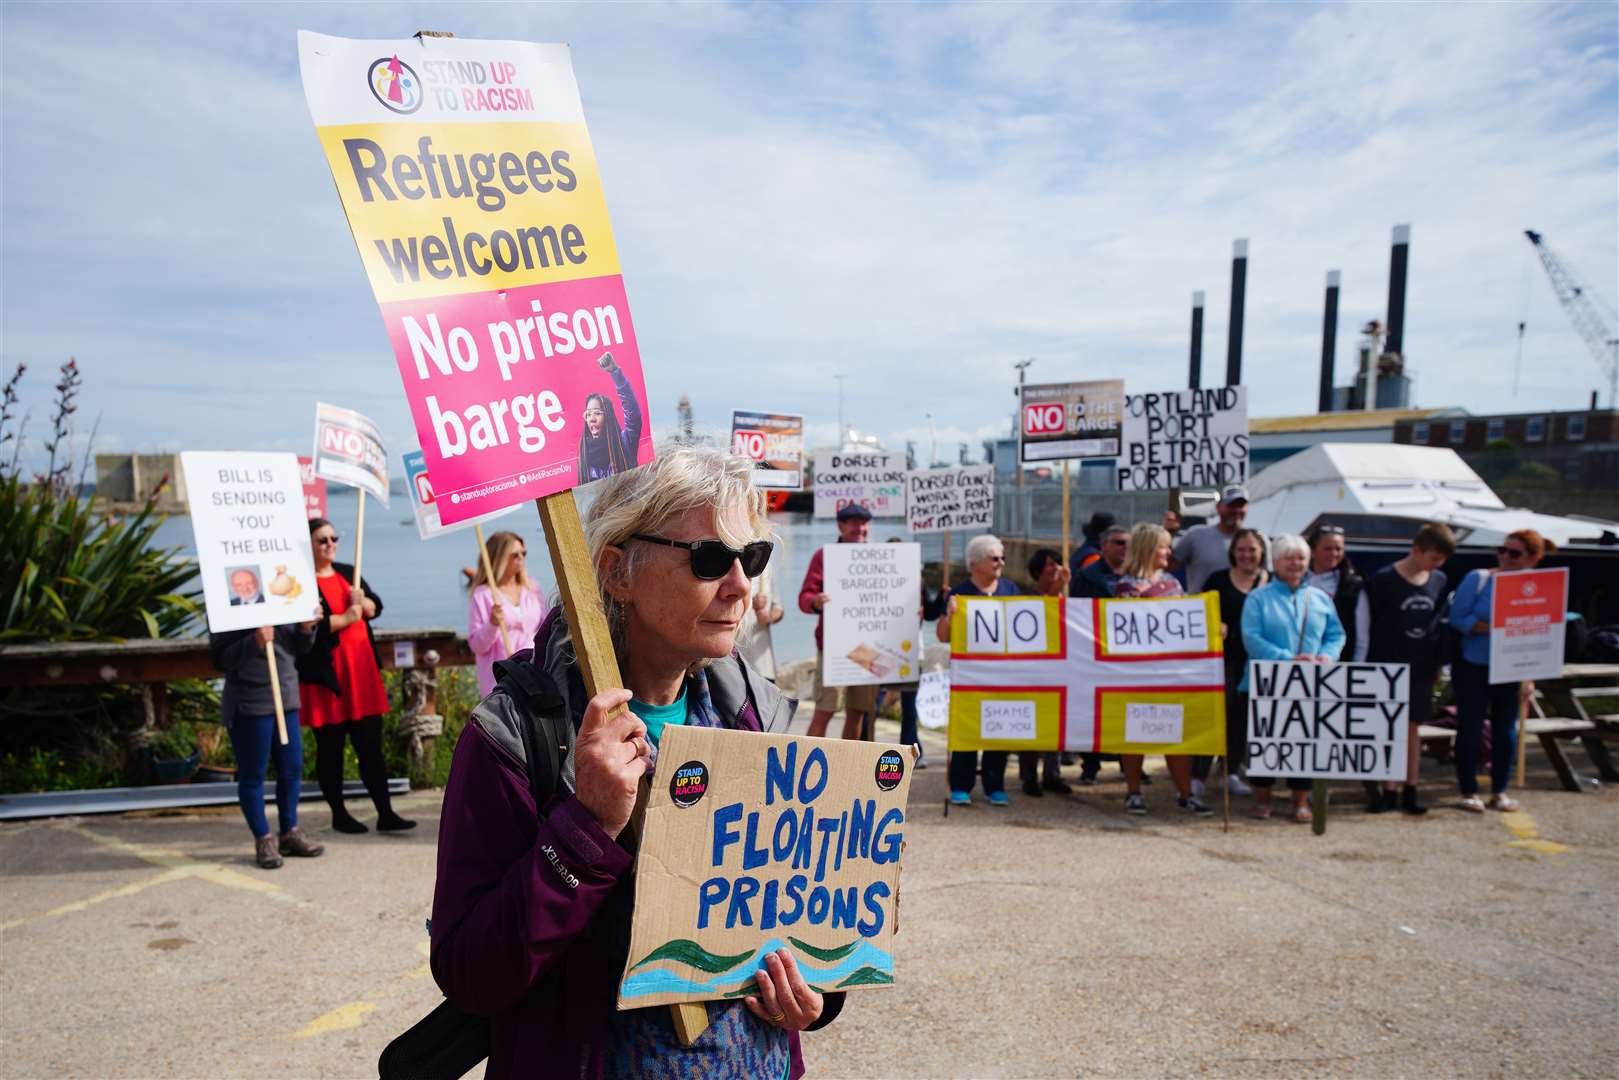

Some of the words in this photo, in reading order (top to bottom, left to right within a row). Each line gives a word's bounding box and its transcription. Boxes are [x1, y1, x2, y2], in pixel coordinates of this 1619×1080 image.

[423, 60, 487, 85] STAND
[489, 60, 517, 85] UP
[431, 88, 459, 111] TO
[462, 88, 535, 111] RACISM
[342, 136, 577, 212] Refugees
[374, 217, 588, 284] welcome
[402, 313, 479, 380] No
[487, 299, 624, 381] prison
[425, 389, 566, 459] barge
[1027, 406, 1063, 431] NO
[1067, 403, 1086, 417] TO
[1090, 400, 1116, 414] THE
[1067, 415, 1118, 432] BARGE
[1148, 412, 1214, 440] PORT
[325, 427, 363, 456] NO
[735, 433, 764, 459] NO
[1130, 434, 1248, 465] BETRAYS
[832, 455, 890, 468] DORSET
[218, 469, 254, 483] BILL
[259, 469, 273, 482] IS
[1118, 461, 1245, 491] PORTLAND!
[212, 491, 286, 506] SENDING
[964, 487, 989, 499] FOR
[913, 517, 935, 531] NOT
[221, 540, 255, 555] THE
[259, 538, 292, 552] BILL
[851, 549, 896, 561] DORSET
[847, 563, 898, 576] COUNCIL
[859, 592, 888, 603] WITH
[842, 606, 904, 618] PORTLAND
[858, 621, 888, 632] PORT
[974, 609, 1039, 643] NO
[1113, 609, 1205, 645] BARGE
[1254, 662, 1406, 700] WAKEY
[984, 705, 1031, 718] SHAME
[1252, 700, 1406, 740] WAKEY
[1009, 721, 1032, 731] YOU
[880, 756, 900, 765] STAND
[1249, 742, 1392, 774] PORTLAND!
[677, 767, 703, 778] STAND
[765, 741, 829, 805] NO
[879, 772, 901, 780] RACISM
[880, 764, 888, 772] UP
[890, 764, 898, 772] TO
[676, 777, 688, 787] UP
[690, 776, 701, 785] TO
[676, 784, 705, 796] RACISM
[712, 799, 904, 883] FLOATING
[697, 875, 891, 938] PRISONS
